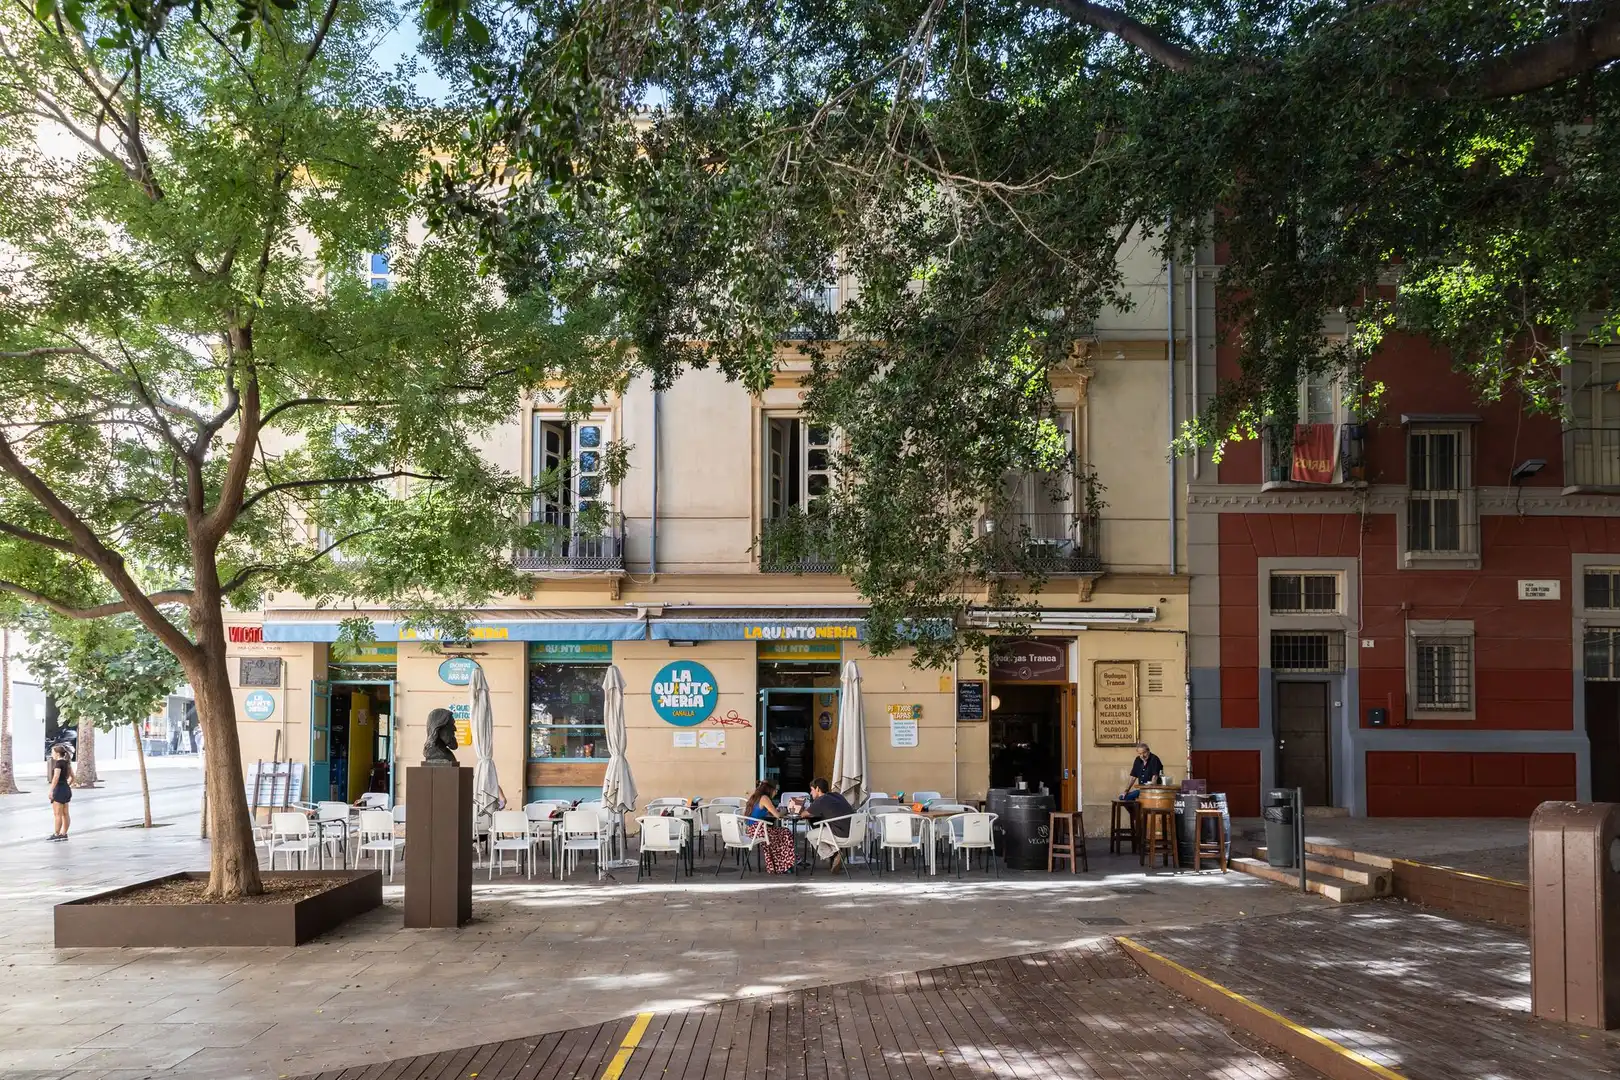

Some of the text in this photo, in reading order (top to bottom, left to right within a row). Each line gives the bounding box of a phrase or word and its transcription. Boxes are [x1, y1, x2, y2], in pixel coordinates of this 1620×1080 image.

[228, 626, 263, 642] VICTO
[1029, 653, 1057, 663] Tranca
[671, 669, 692, 683] LA
